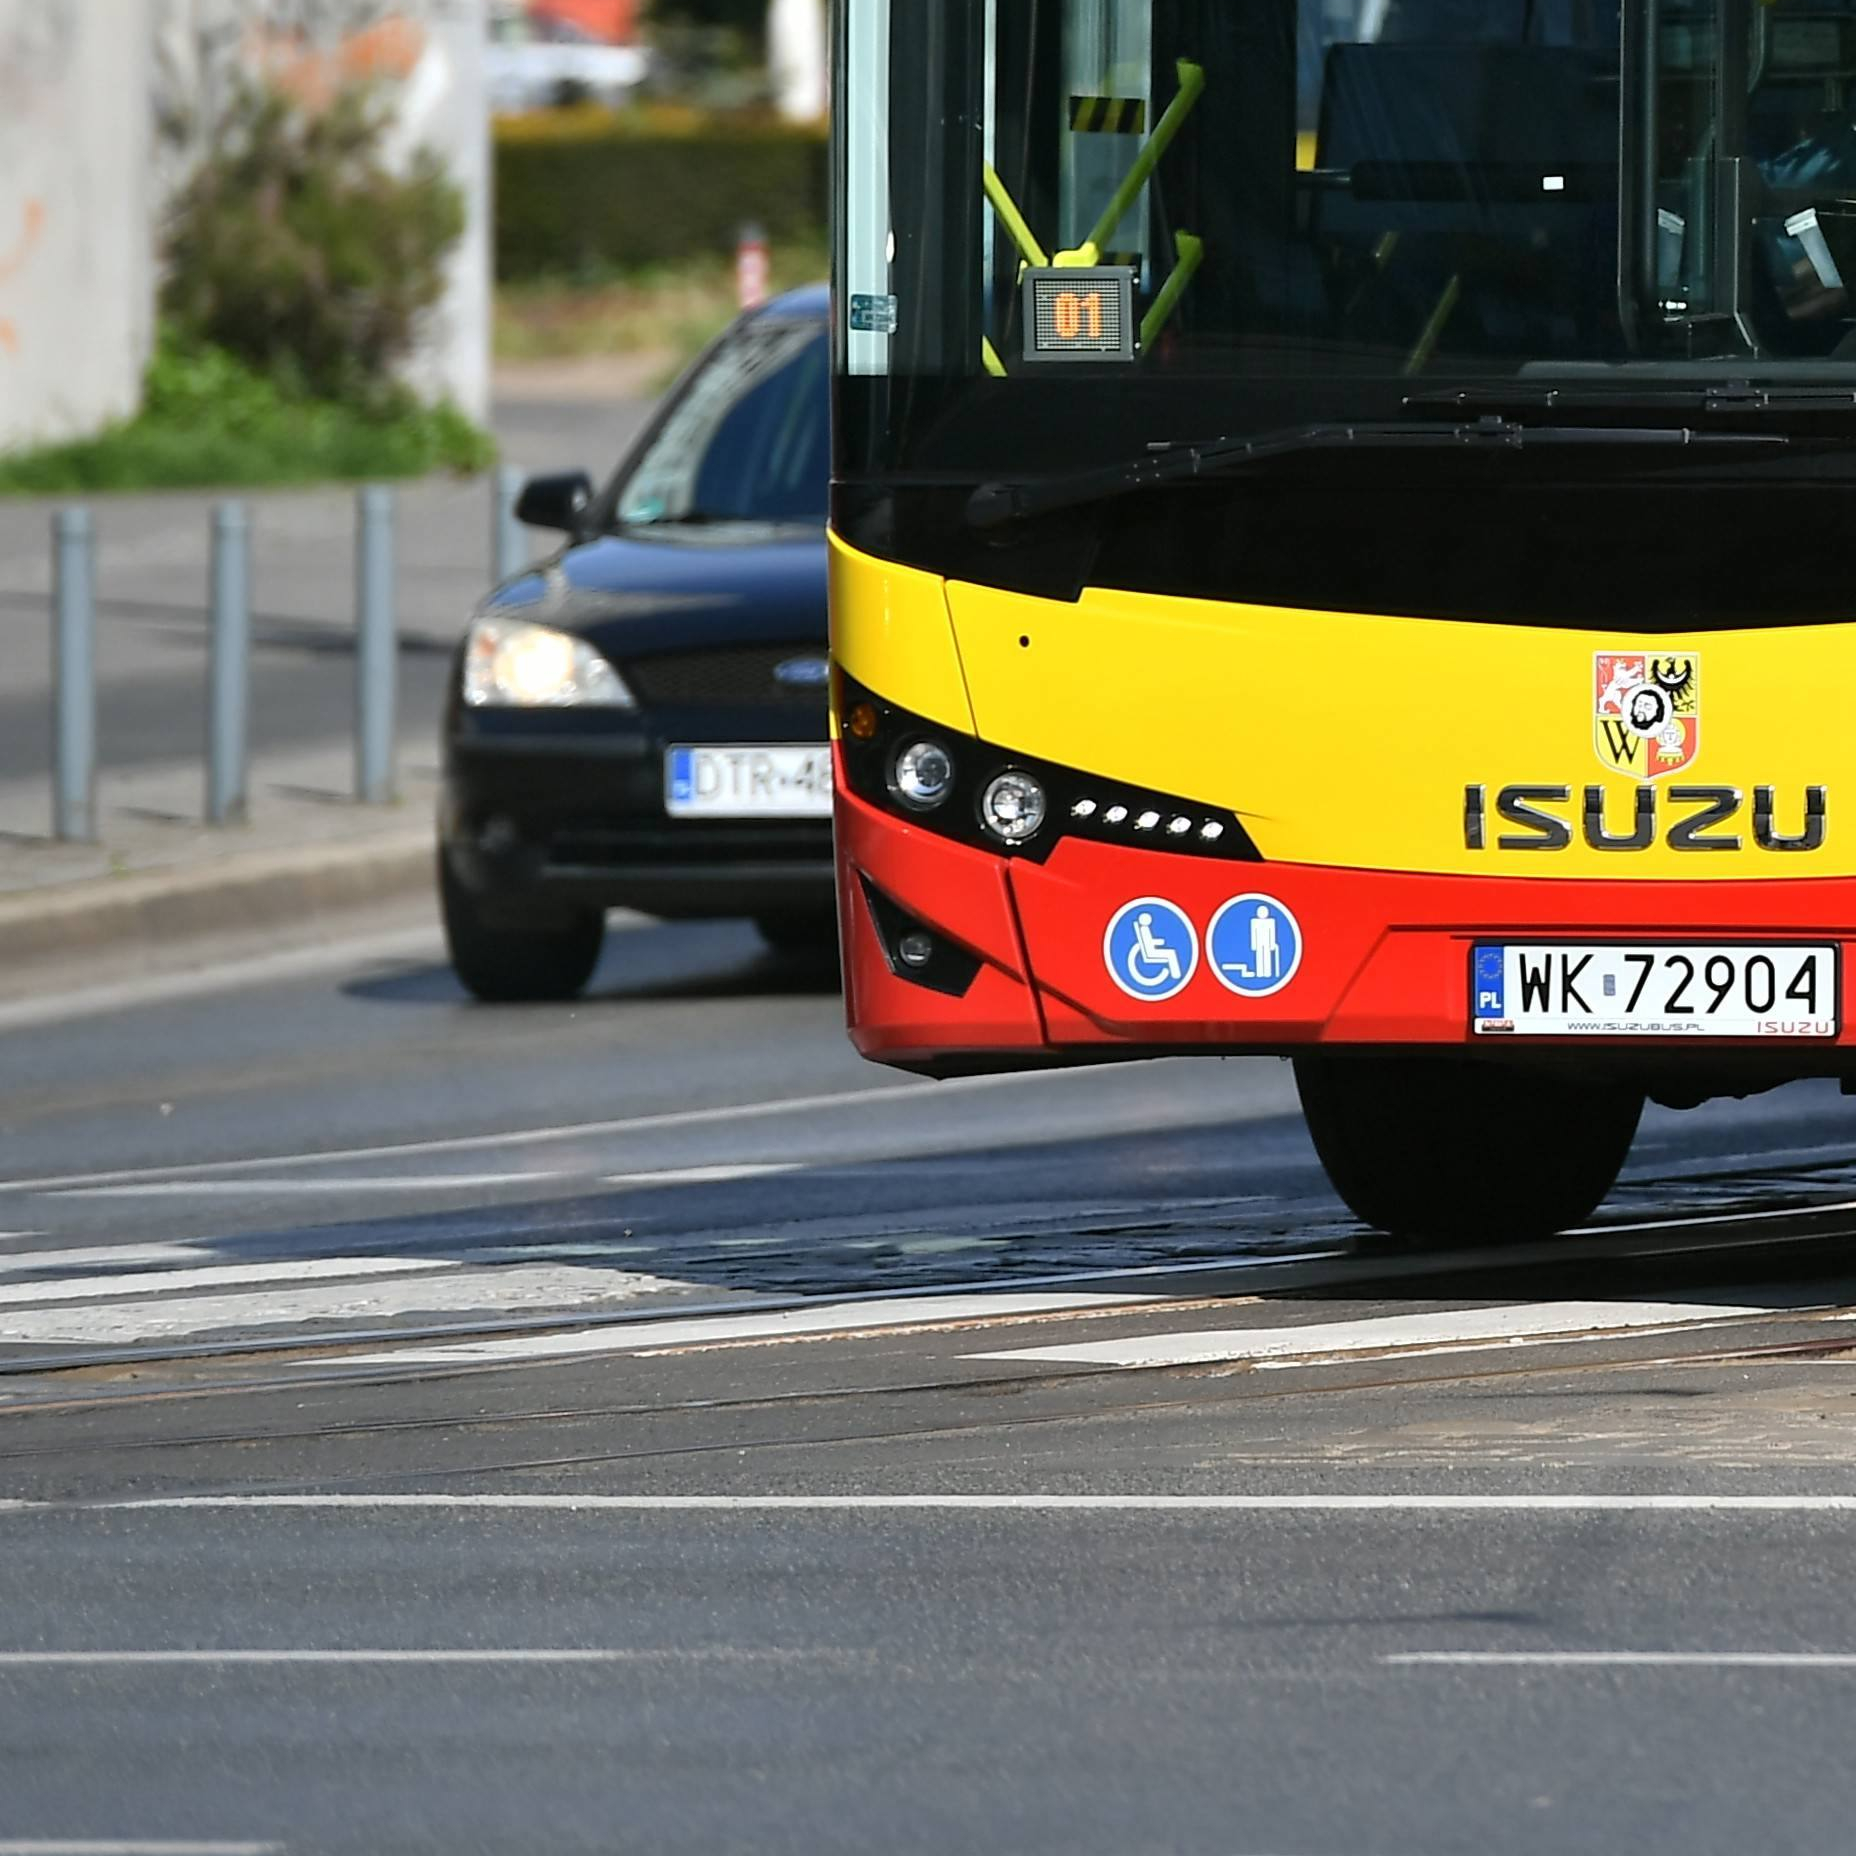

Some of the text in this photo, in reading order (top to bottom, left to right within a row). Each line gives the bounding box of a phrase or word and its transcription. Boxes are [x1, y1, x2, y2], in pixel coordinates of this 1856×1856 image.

[1053, 290, 1103, 338] 01
[1463, 783, 1828, 852] ISUZU
[1480, 992, 1502, 1009] PL
[1518, 953, 1817, 1014] WK 72904
[1757, 1021, 1830, 1034] ISUZU
